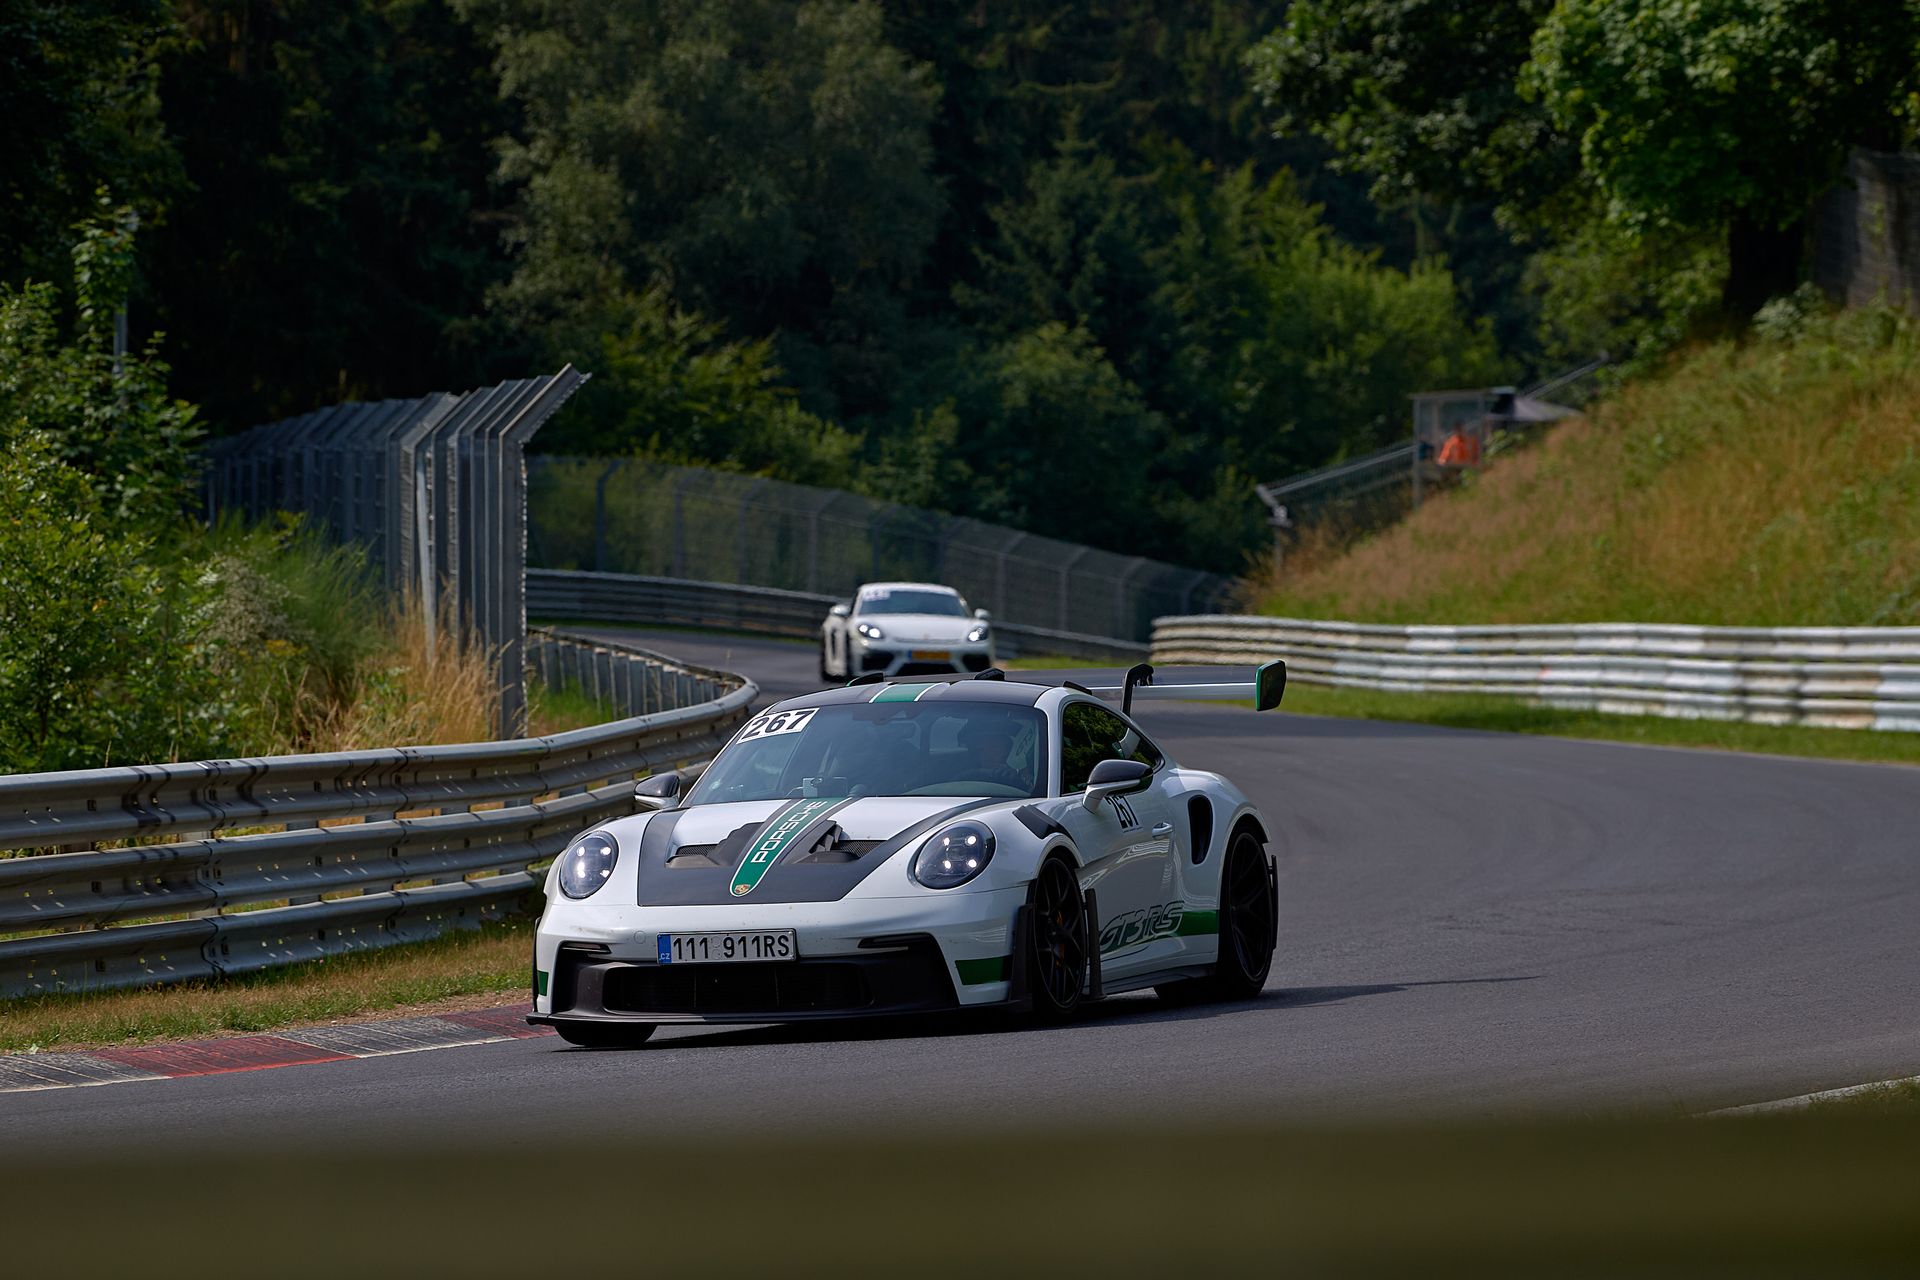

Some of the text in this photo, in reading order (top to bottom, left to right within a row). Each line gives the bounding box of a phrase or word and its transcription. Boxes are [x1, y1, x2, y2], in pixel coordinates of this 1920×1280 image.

[742, 709, 816, 740] 267
[750, 800, 828, 863] PORSCHE
[660, 952, 670, 960] CZ
[673, 934, 790, 960] 111 911RS
